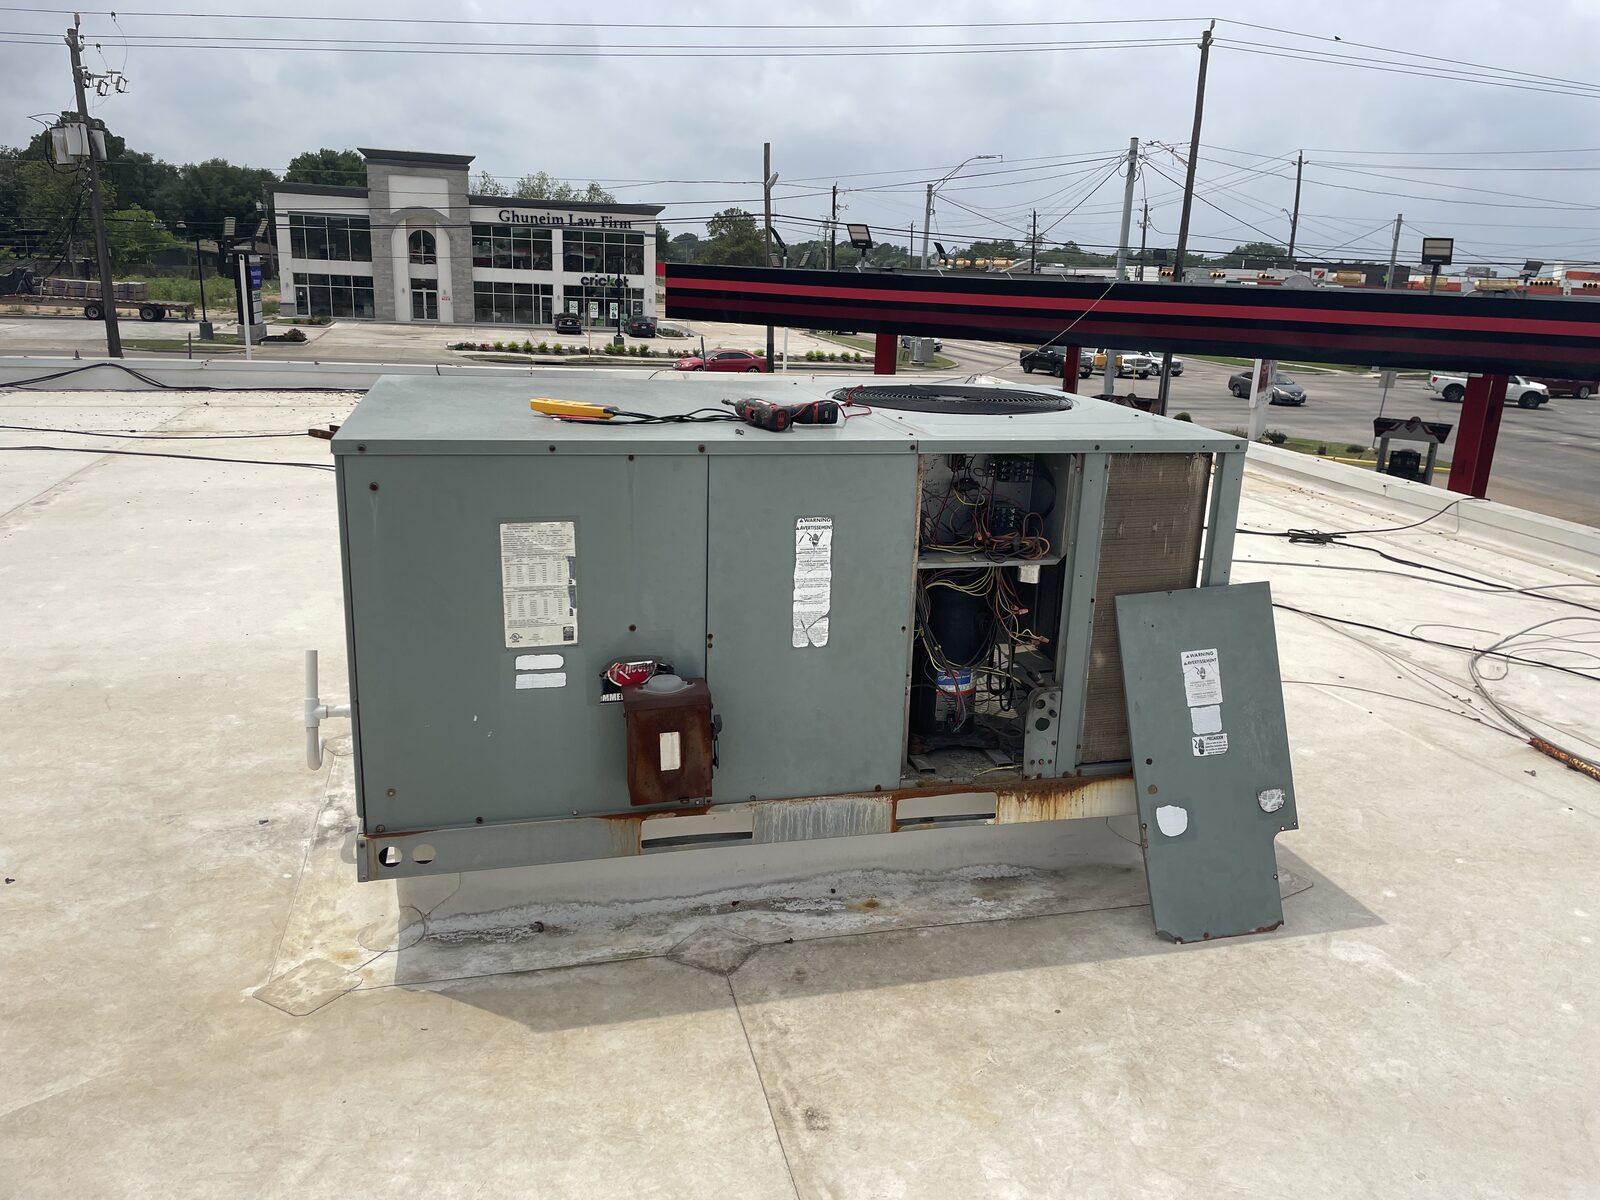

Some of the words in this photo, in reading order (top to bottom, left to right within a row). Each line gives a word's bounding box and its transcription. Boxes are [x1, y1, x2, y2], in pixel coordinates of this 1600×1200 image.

[498, 209, 565, 225] Ghuneim
[568, 213, 597, 227] Law
[600, 215, 632, 229] Firm
